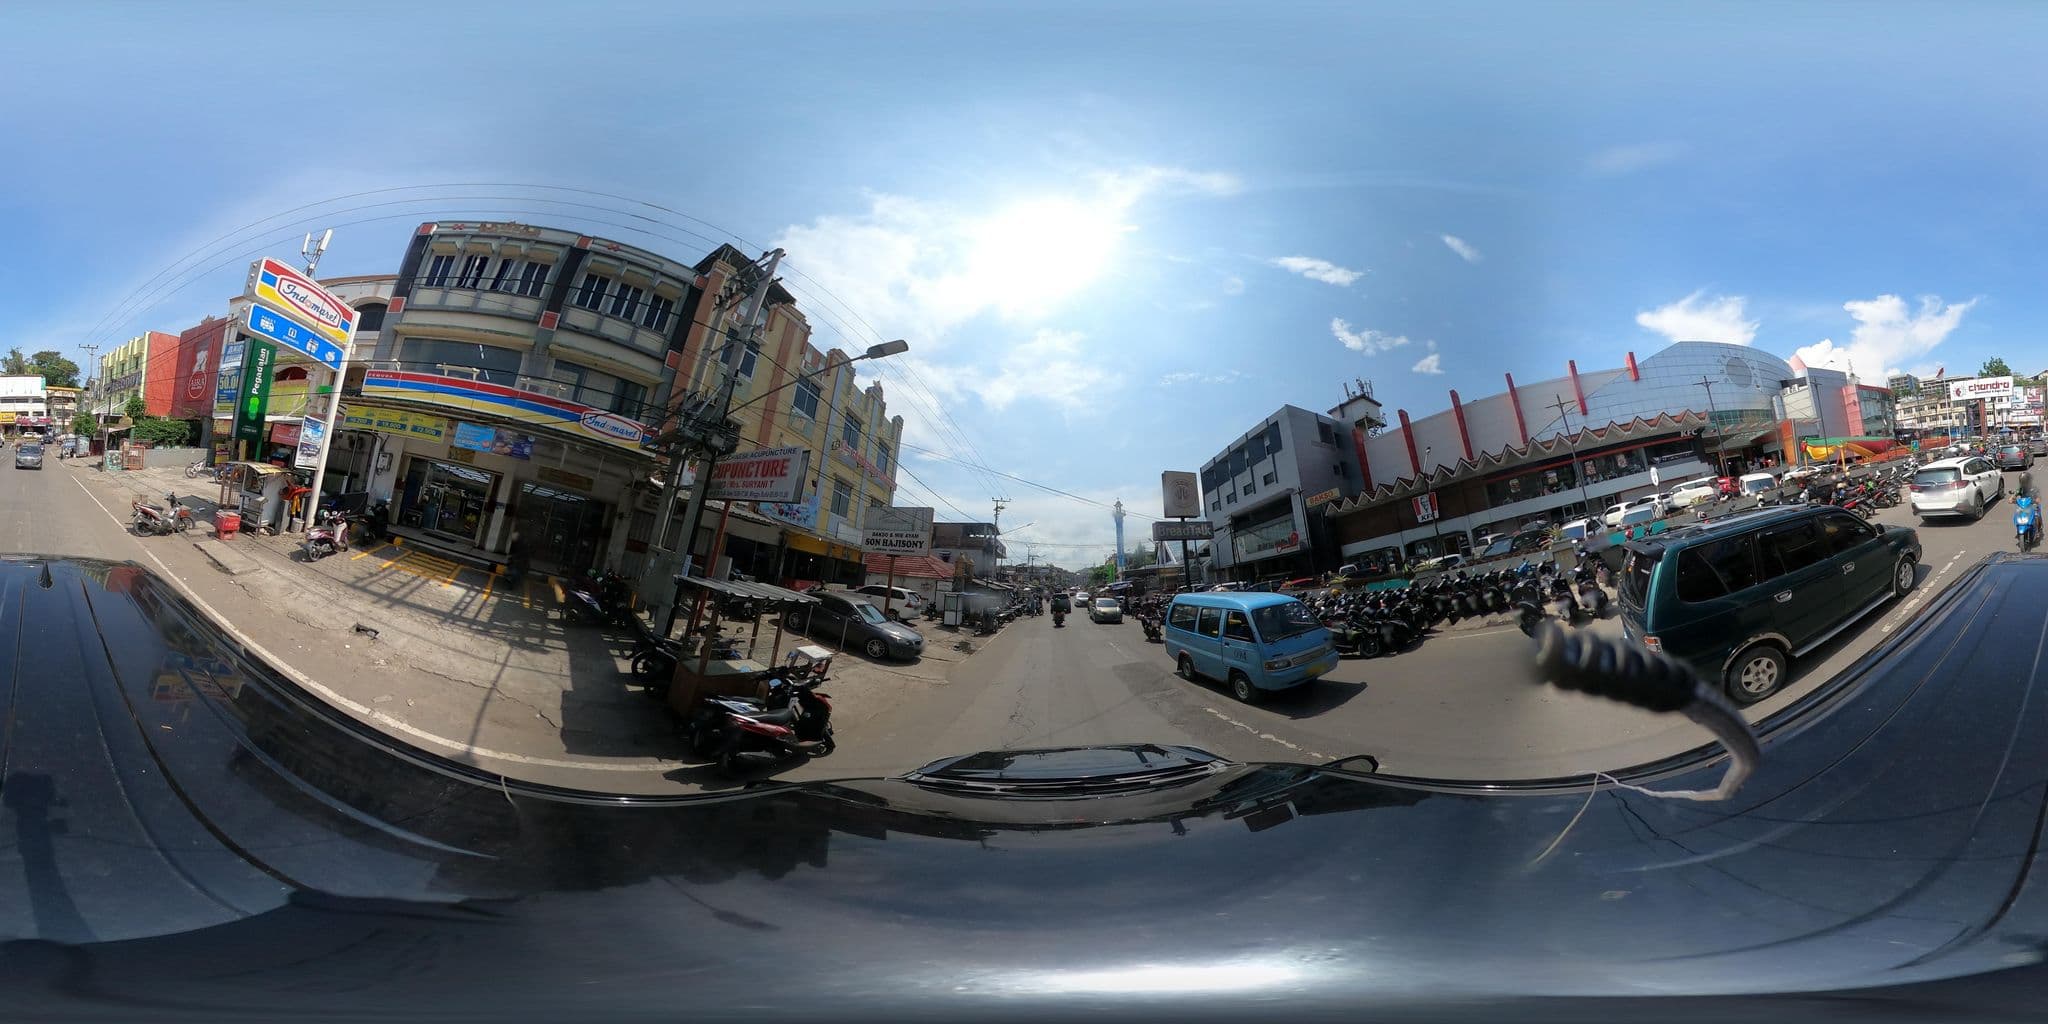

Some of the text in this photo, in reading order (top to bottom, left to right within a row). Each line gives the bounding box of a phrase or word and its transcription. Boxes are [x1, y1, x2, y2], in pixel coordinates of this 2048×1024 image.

[282, 283, 337, 323] Indomaret
[1968, 381, 2010, 392] chandra
[585, 415, 638, 438] Indomaret
[1681, 428, 1698, 437] KFC
[751, 447, 797, 458] ACUPUNCTURE
[712, 459, 791, 479] CUPUNCTURE
[742, 480, 768, 489] SURYANI
[1310, 490, 1334, 504] BAKSO
[865, 537, 925, 548] SON HAJISONY
